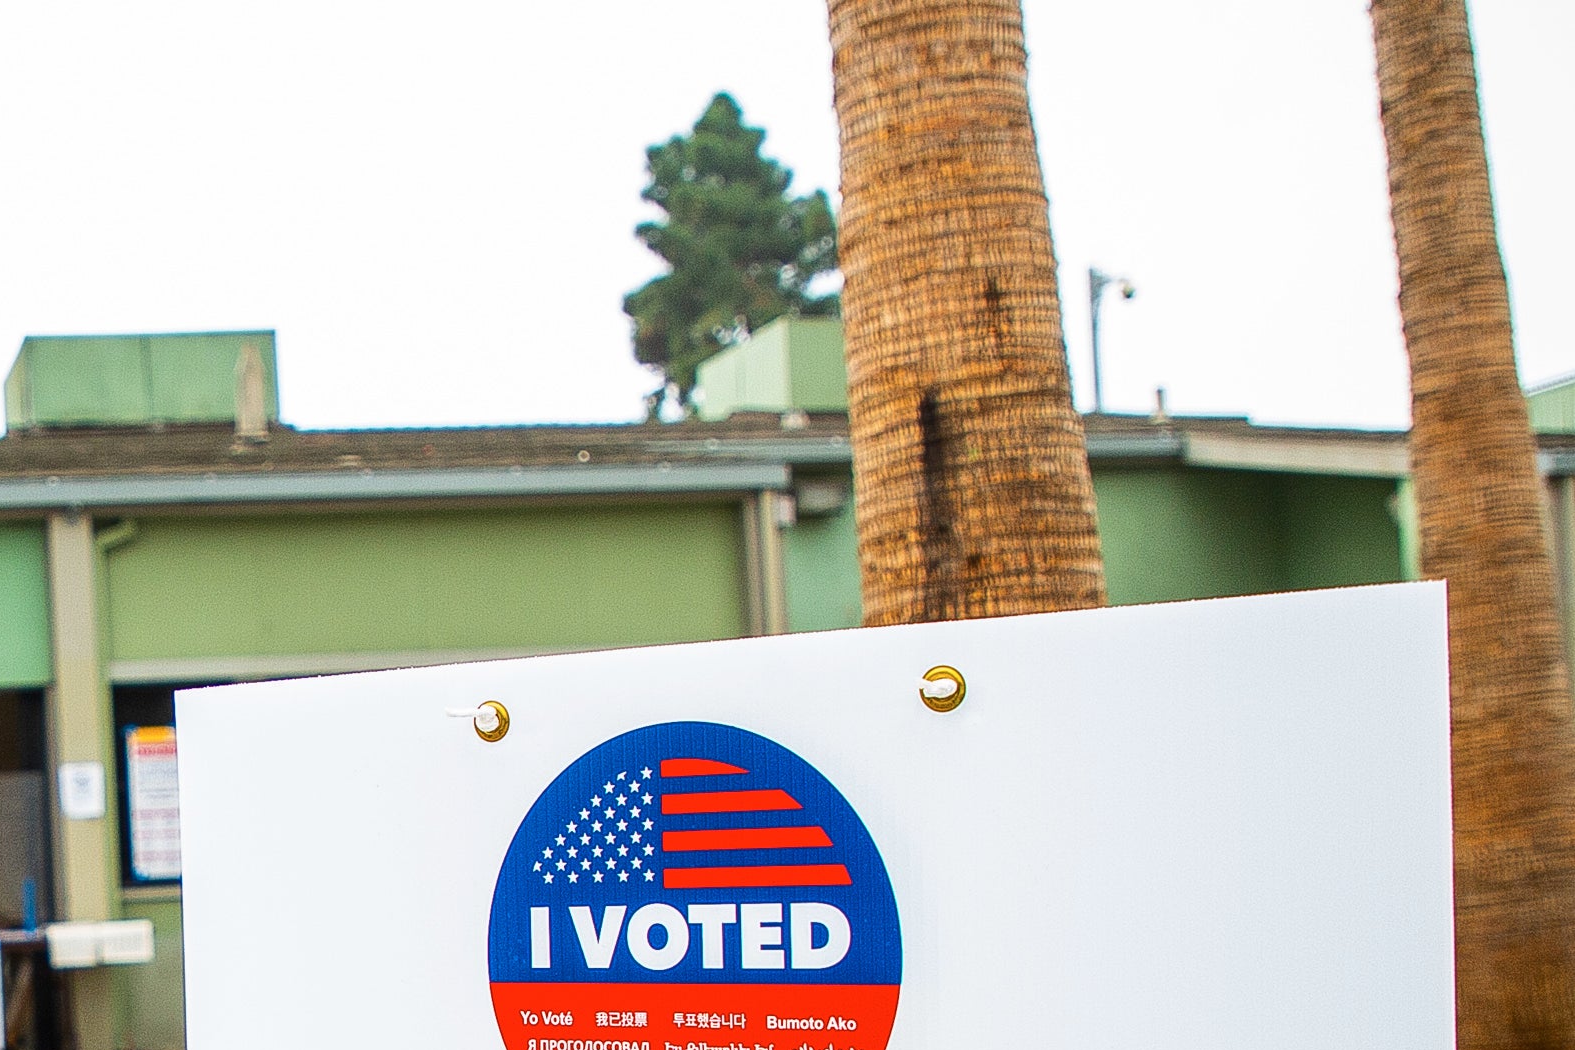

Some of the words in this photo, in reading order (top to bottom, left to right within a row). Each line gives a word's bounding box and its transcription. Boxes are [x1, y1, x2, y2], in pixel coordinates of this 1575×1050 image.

[529, 906, 551, 970] I
[567, 902, 852, 970] VOTED
[520, 1010, 539, 1026] Yo
[541, 1010, 574, 1026] Voté
[595, 1011, 648, 1027] 我已投票
[672, 1012, 747, 1029] 투표했습니다
[766, 1015, 824, 1030] Bumoto
[826, 1016, 857, 1031] Ako
